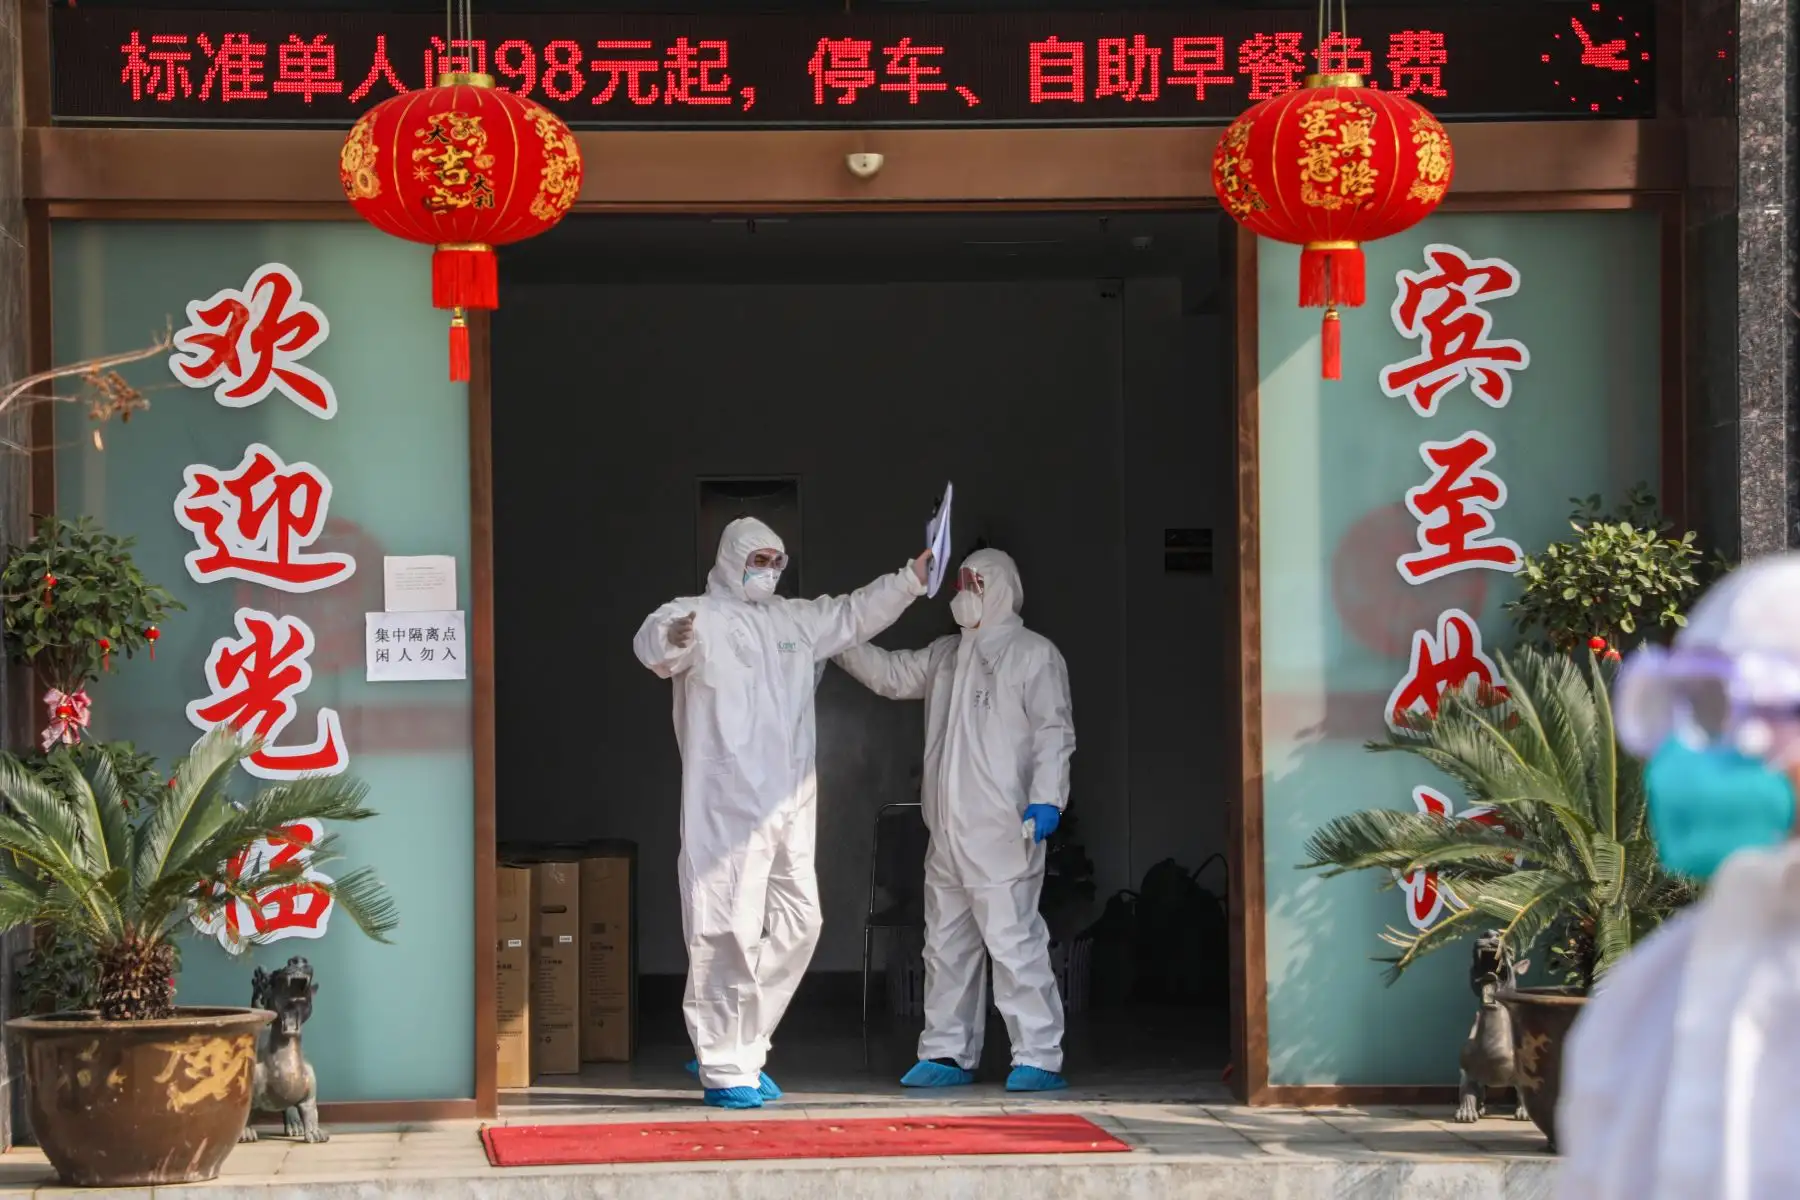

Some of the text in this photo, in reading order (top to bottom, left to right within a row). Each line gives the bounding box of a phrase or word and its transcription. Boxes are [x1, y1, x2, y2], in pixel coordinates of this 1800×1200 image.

[375, 627, 457, 643] 集中隔离点
[375, 646, 457, 662] 闲人勿入
